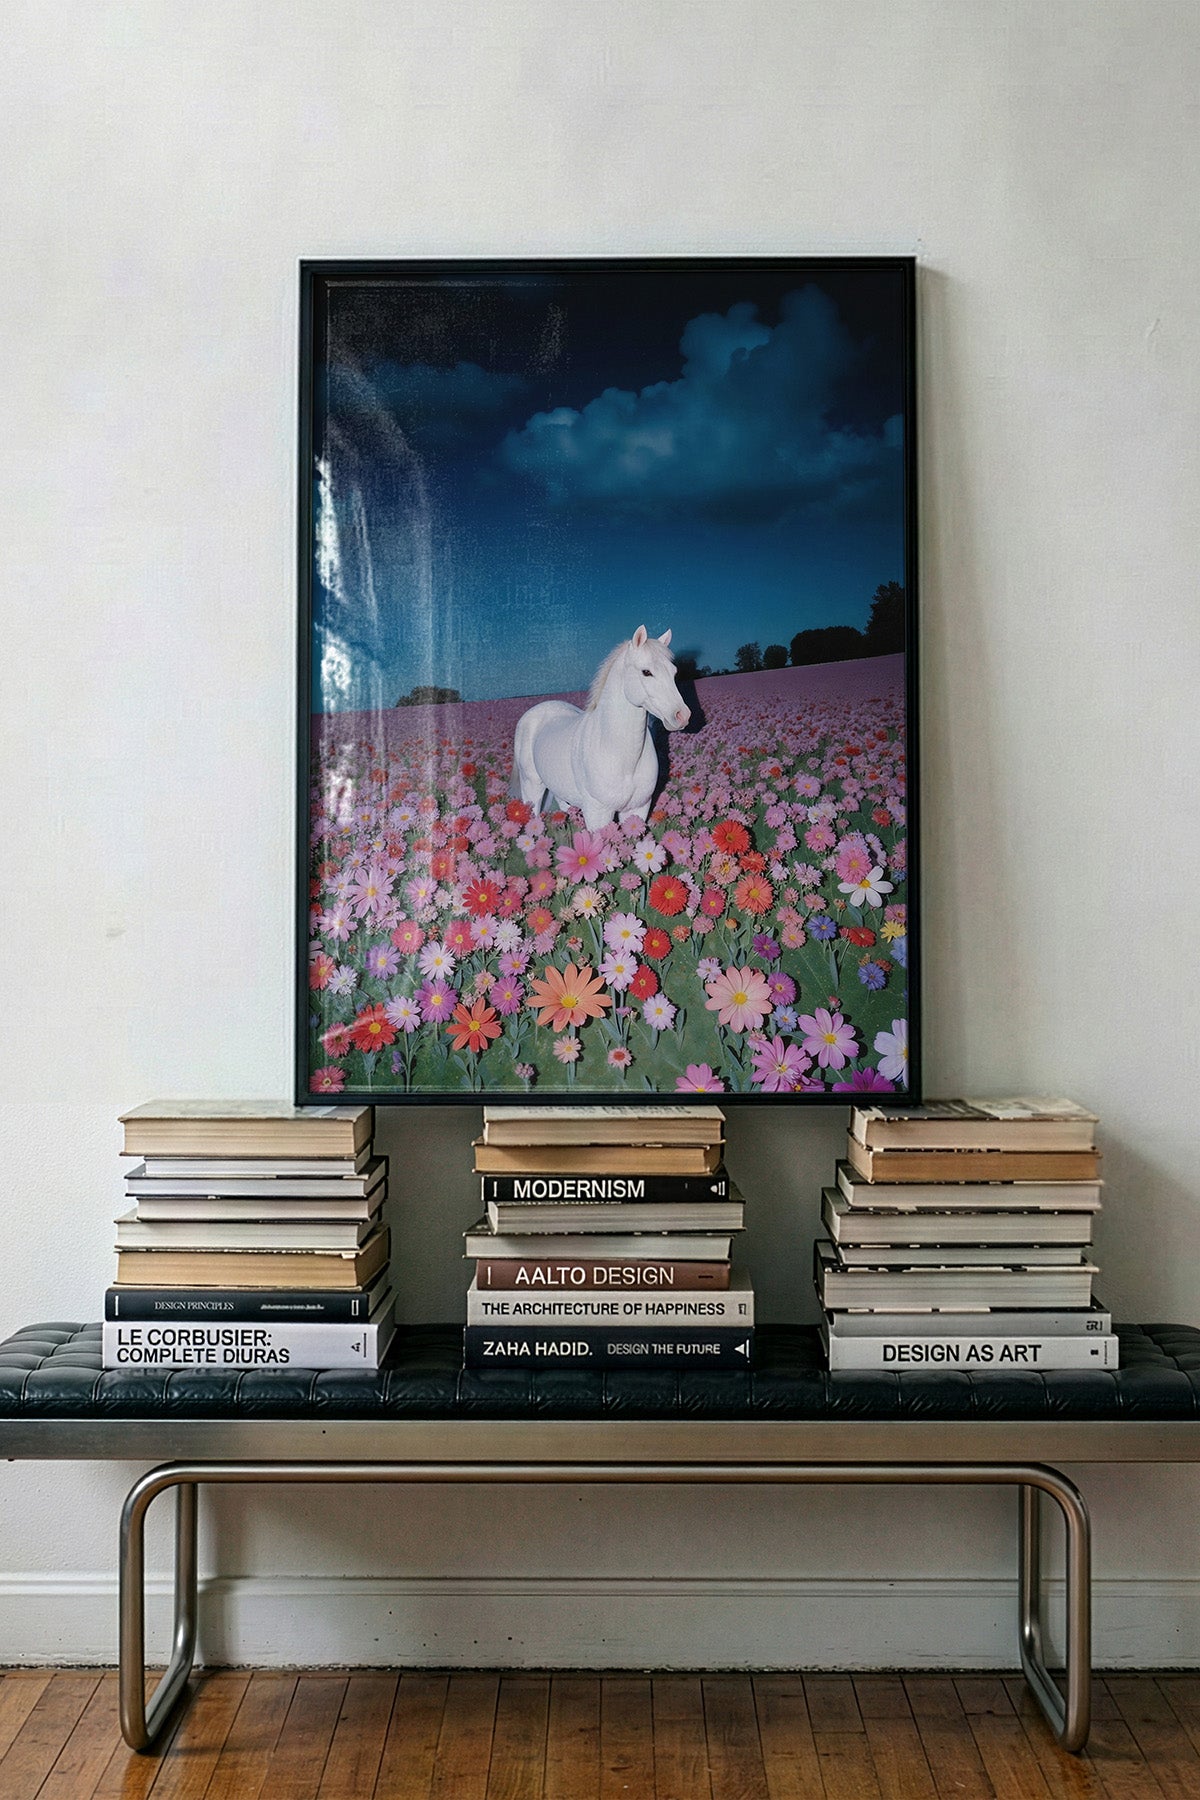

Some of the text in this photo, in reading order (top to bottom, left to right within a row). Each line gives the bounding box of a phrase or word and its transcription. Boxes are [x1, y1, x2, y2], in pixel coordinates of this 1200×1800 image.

[514, 1180, 645, 1198] MODERNISM
[515, 1266, 674, 1285] AALTO DESIGN
[155, 1301, 235, 1310] DESIGN PRINCIPLES
[482, 1303, 510, 1315] THE
[512, 1303, 619, 1315] ARCHITECTURE
[623, 1303, 642, 1315] OF
[645, 1303, 725, 1315] HAPPINESS
[118, 1329, 272, 1346] LE CORBUSIER:
[117, 1348, 290, 1364] COMPLETE DIURAS
[483, 1341, 593, 1356] ZAHA HADID.
[607, 1343, 721, 1355] DESIGN THE FUTURE
[883, 1345, 1042, 1362] DESIGN AS ART
